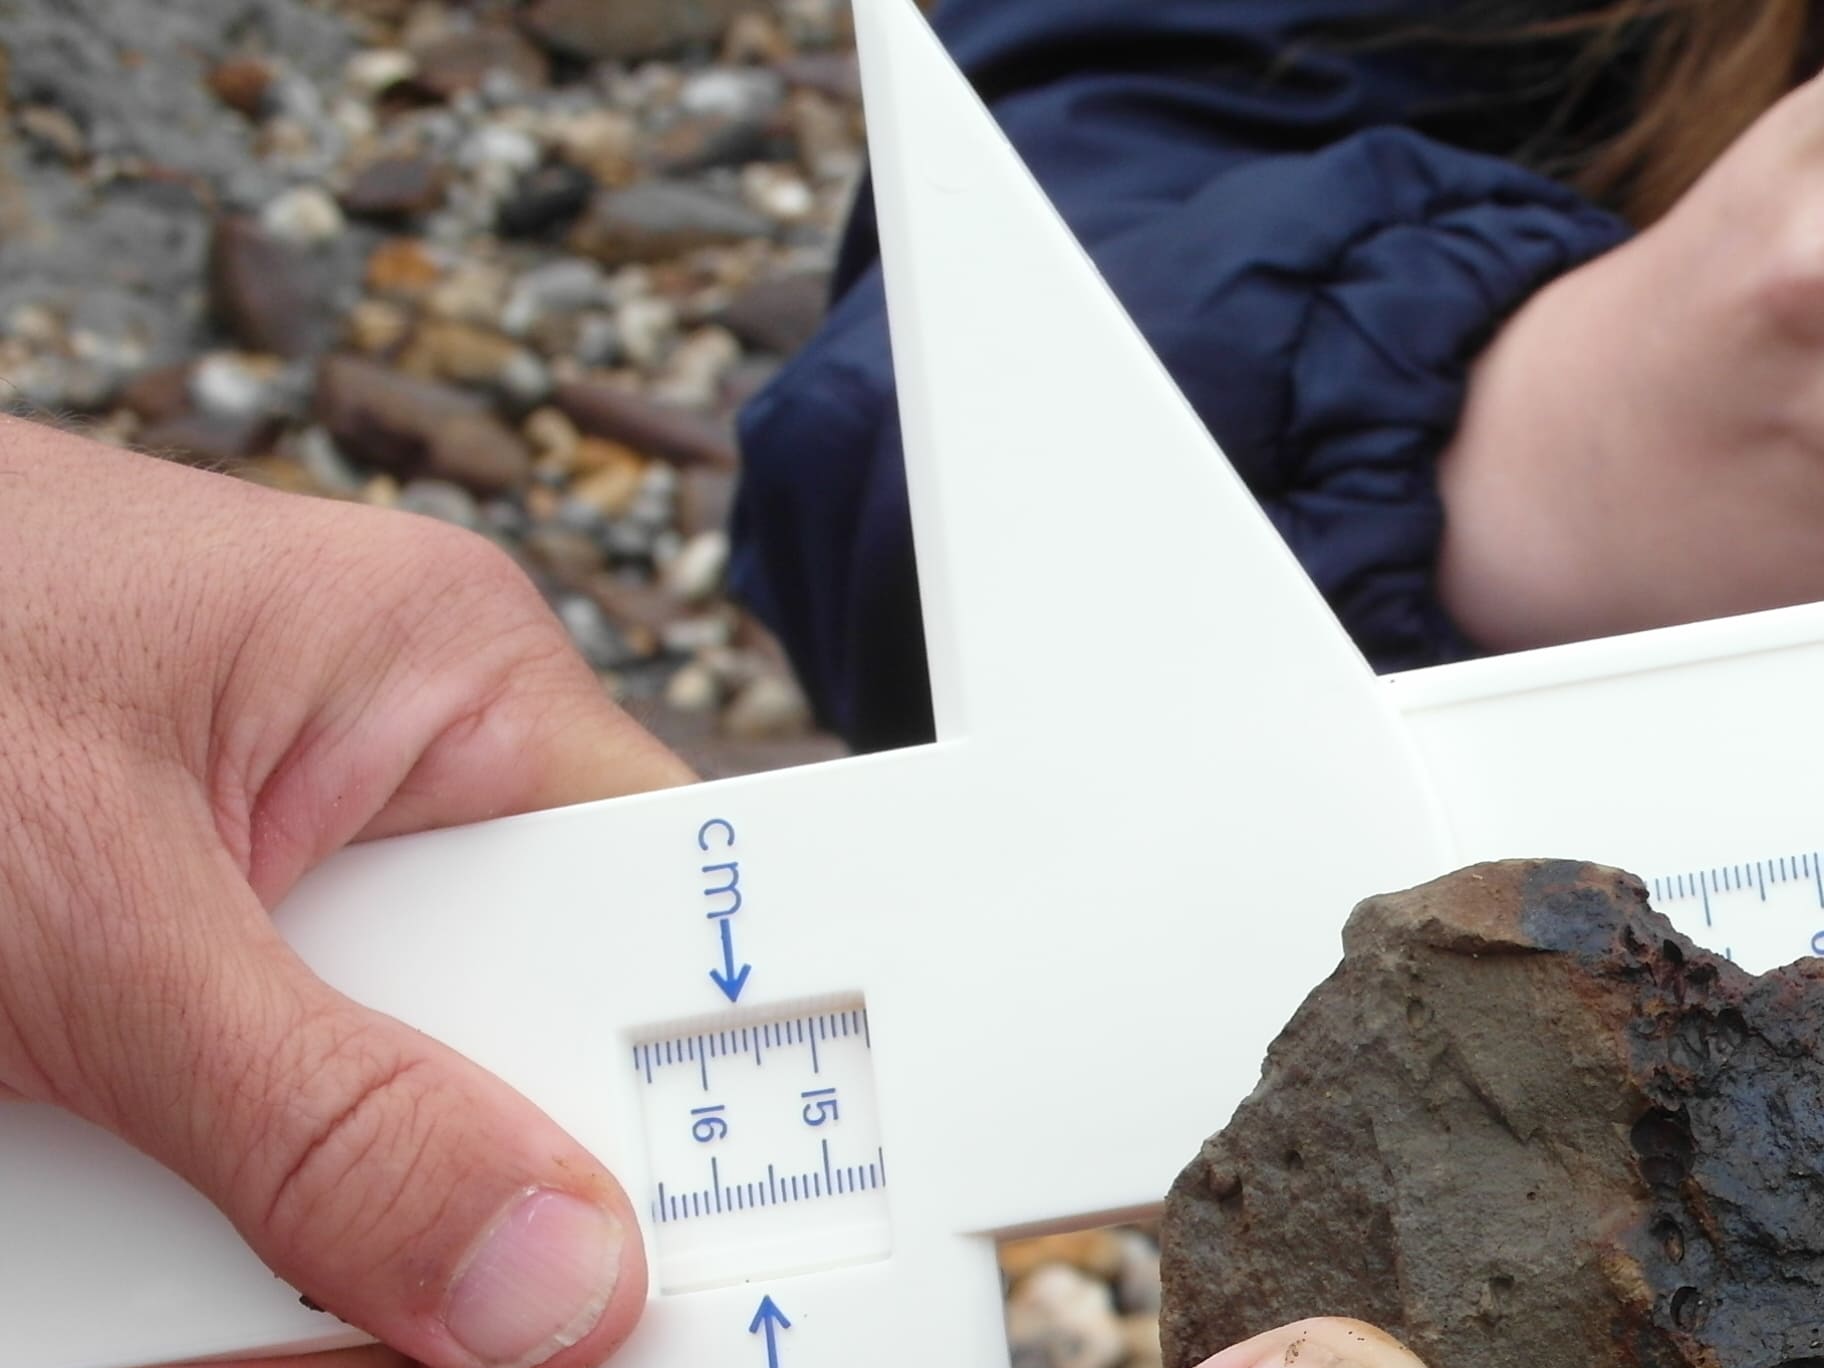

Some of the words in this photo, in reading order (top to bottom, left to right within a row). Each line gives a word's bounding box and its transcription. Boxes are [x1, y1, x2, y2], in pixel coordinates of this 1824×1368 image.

[696, 817, 743, 920] cm
[689, 1103, 729, 1144] 16
[800, 1087, 840, 1127] 15
